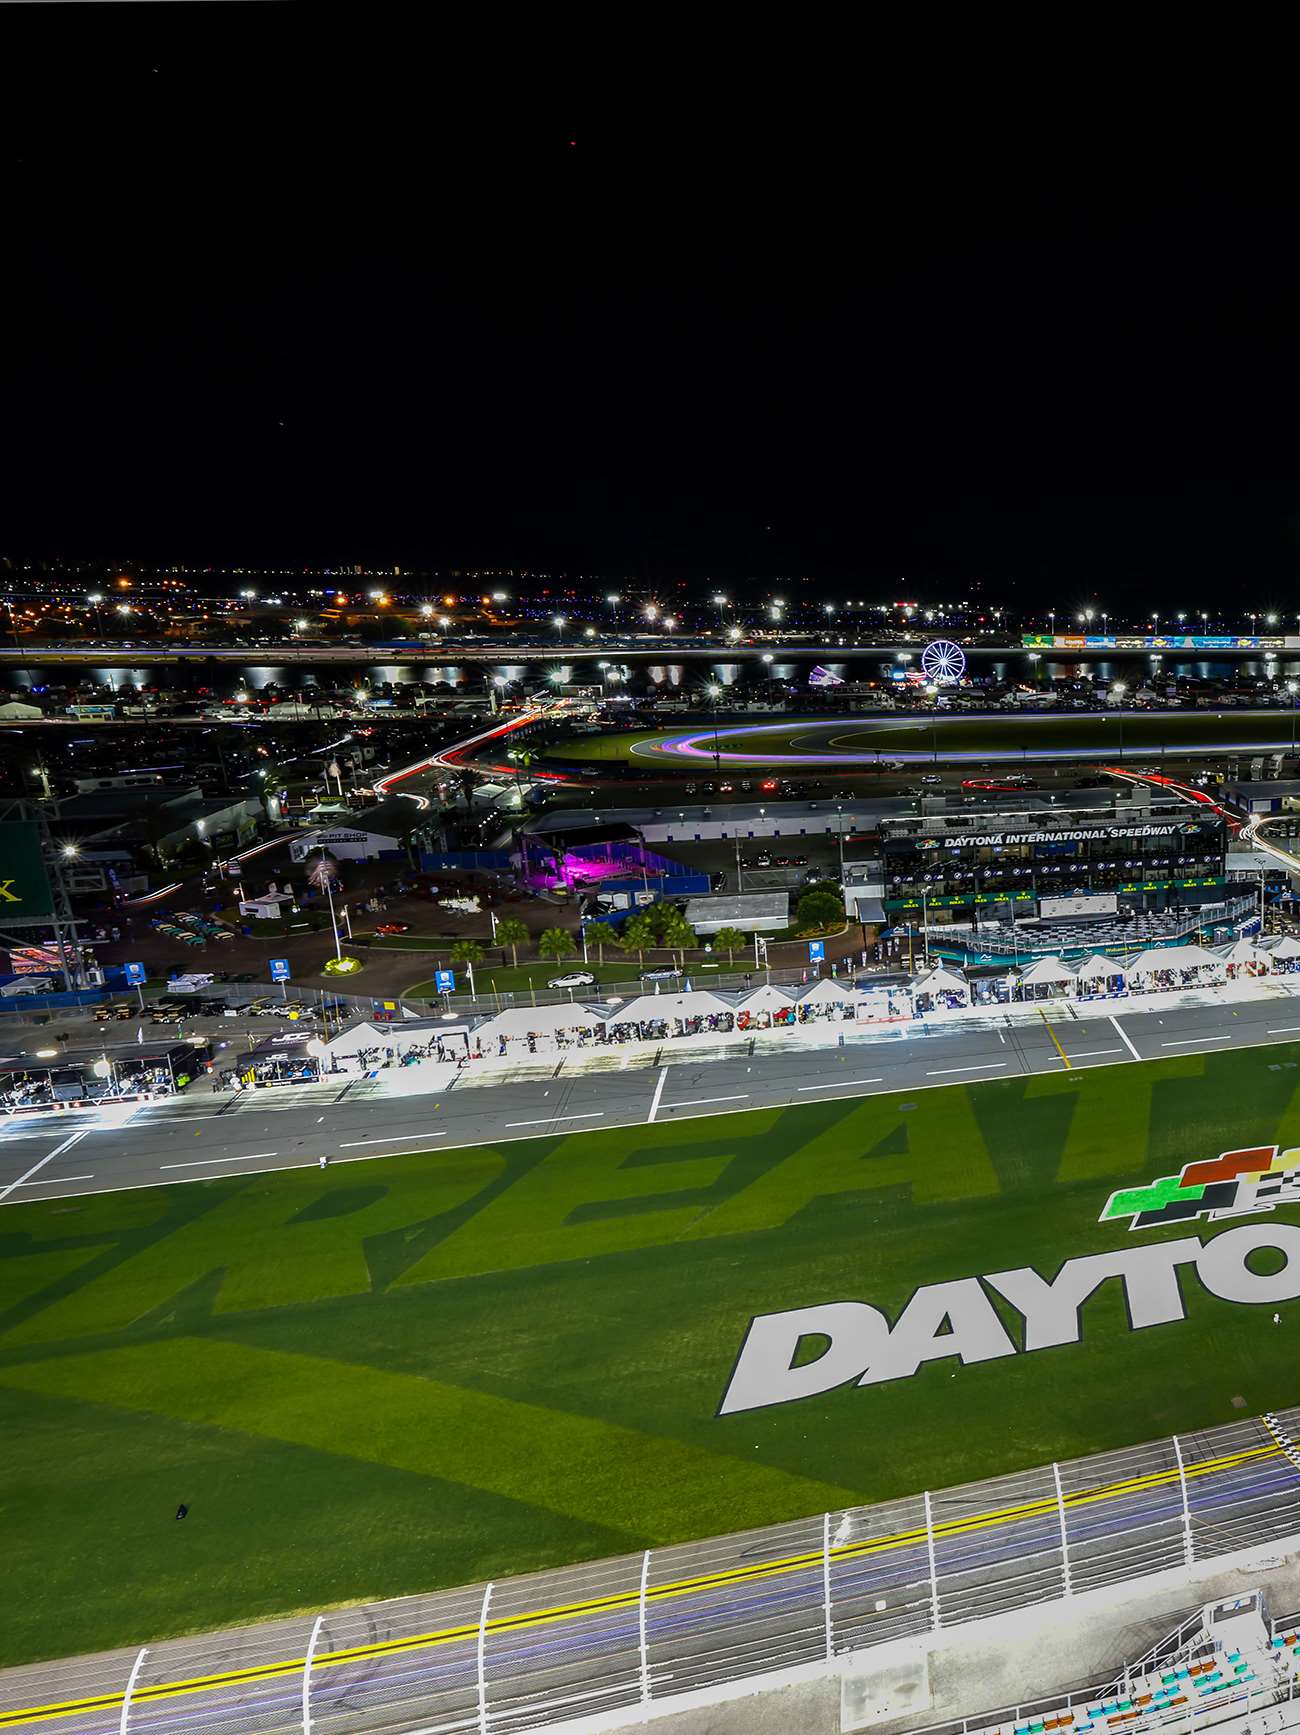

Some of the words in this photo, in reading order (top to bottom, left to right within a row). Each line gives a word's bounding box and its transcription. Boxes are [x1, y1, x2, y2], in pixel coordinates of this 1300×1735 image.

[944, 834, 1003, 847] DAYTONA
[1005, 830, 1107, 844] INTERNATIONAL
[1110, 825, 1176, 838] SPEEDWAY
